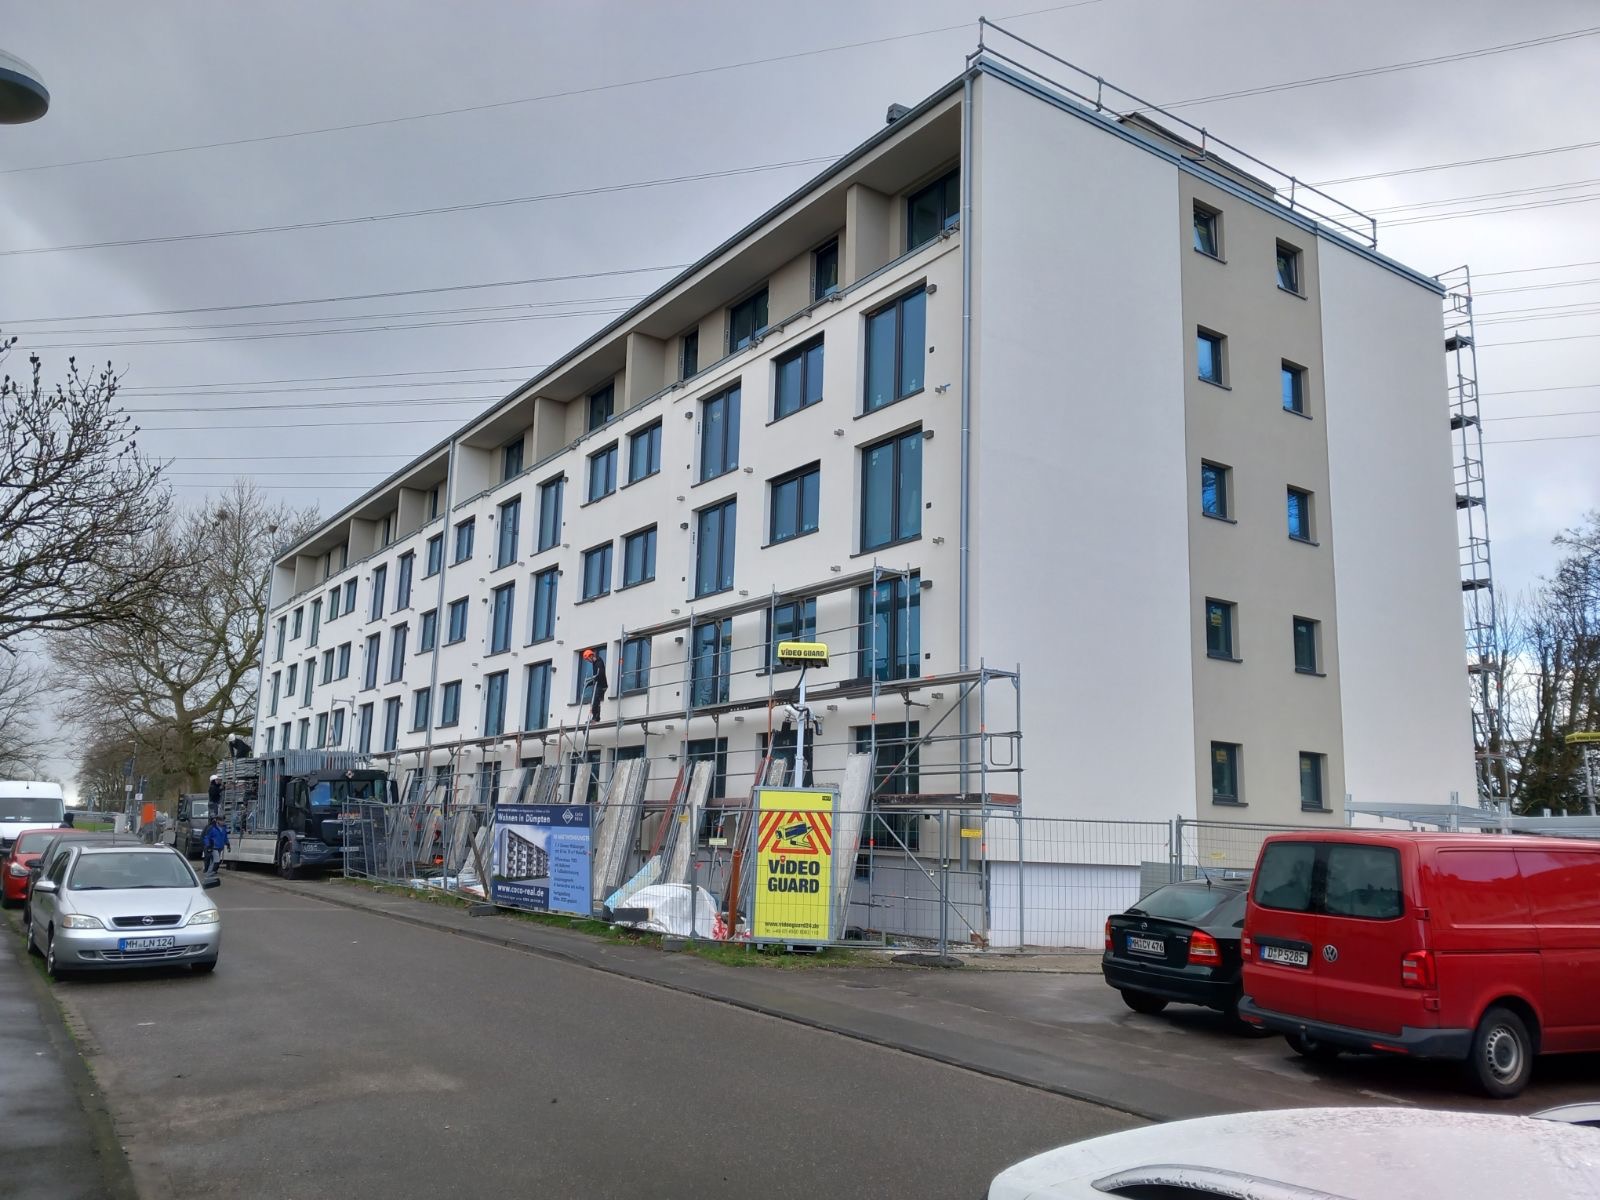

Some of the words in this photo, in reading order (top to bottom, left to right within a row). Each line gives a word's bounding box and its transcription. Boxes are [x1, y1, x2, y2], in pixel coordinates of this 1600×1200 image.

[497, 812, 518, 821] Wohnen
[519, 814, 524, 822] in
[525, 814, 551, 824] Dümpten
[497, 885, 544, 897] www.coco-real.de
[767, 877, 820, 894] GUARD
[765, 921, 819, 929] www.videoguard24.de
[125, 940, 138, 949] MH
[143, 939, 155, 948] LN
[157, 938, 172, 947] 124
[1142, 940, 1151, 950] CY
[1151, 942, 1164, 952] 476
[1267, 947, 1274, 958] D
[1284, 949, 1305, 963] 5285
